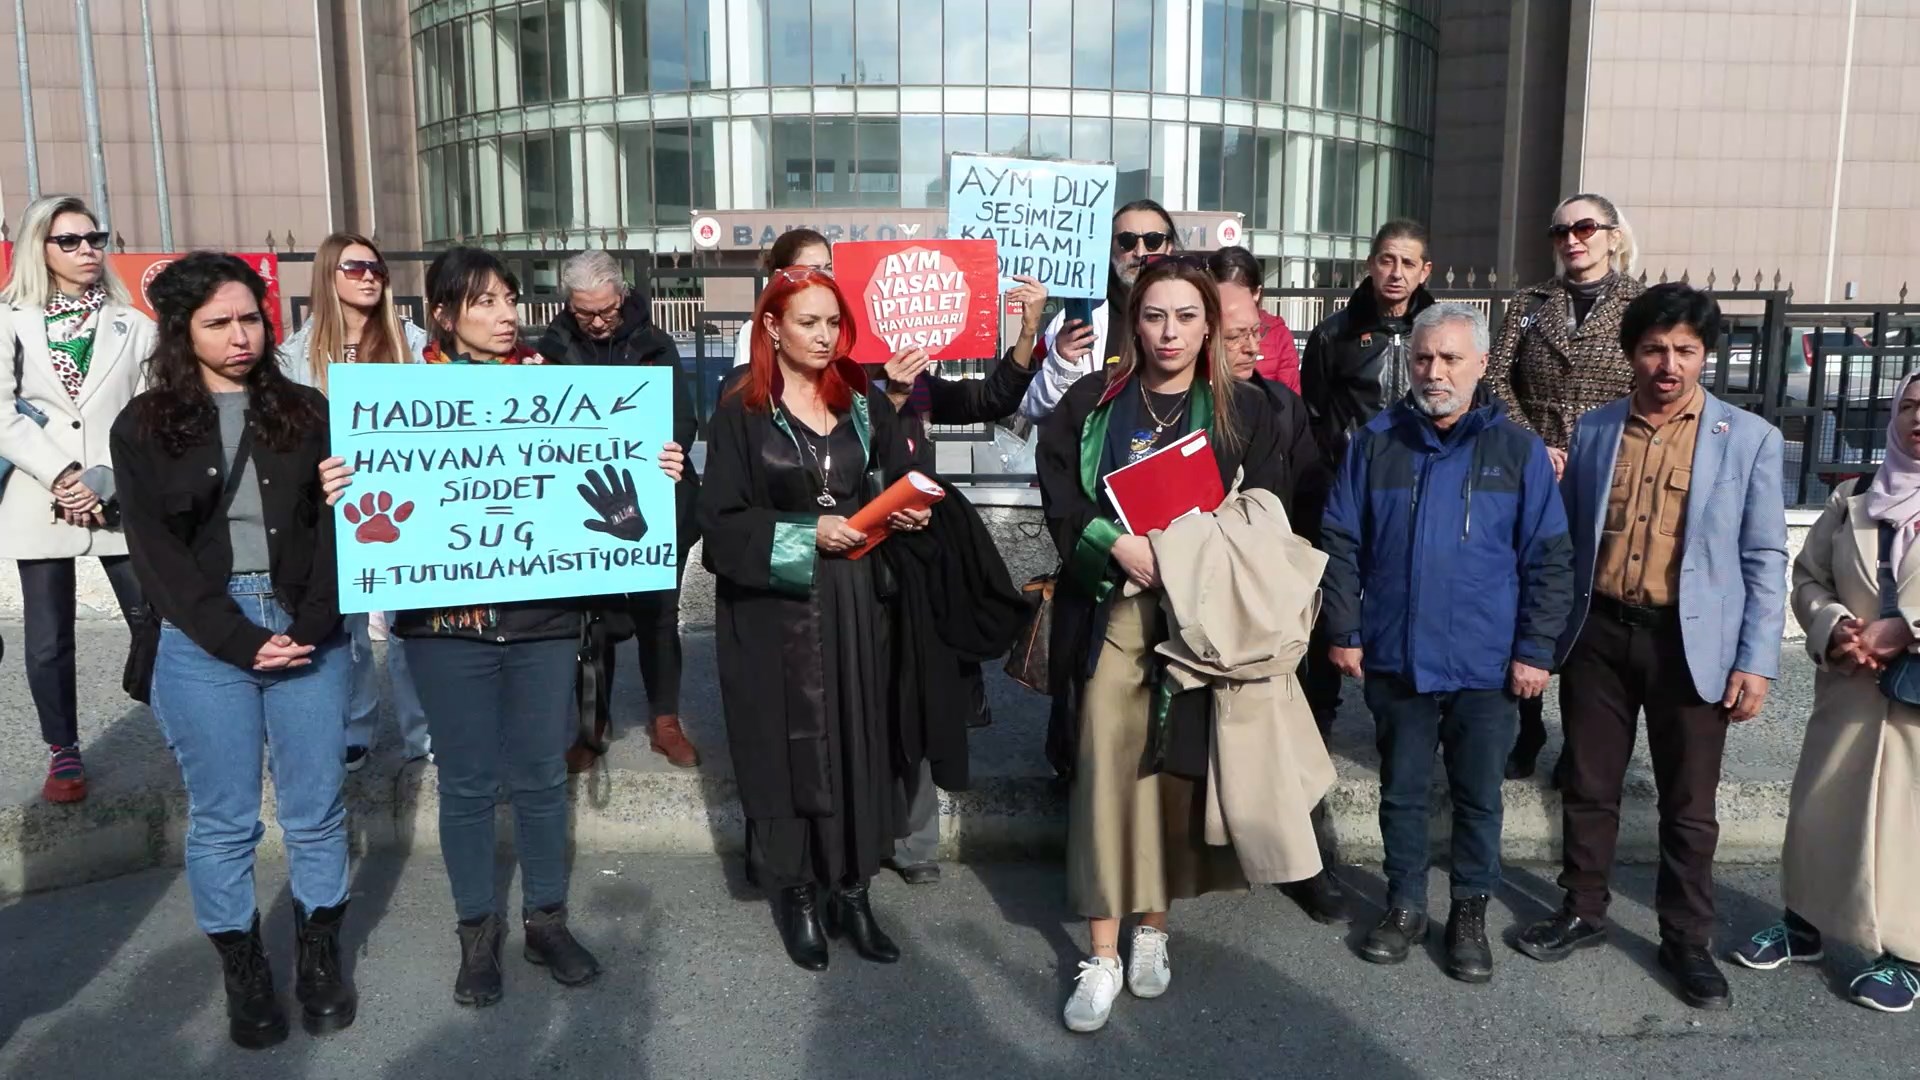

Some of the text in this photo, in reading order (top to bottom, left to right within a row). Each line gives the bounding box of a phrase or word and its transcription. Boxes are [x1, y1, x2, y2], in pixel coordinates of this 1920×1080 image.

[957, 165, 1109, 208] AYM DUY
[885, 250, 941, 277] AYM
[876, 271, 965, 299] YASAYI
[871, 292, 966, 320] İPTAL ET
[878, 312, 964, 333] HAYVANLARI
[355, 438, 648, 473] HAYVANA YÖNELİK
